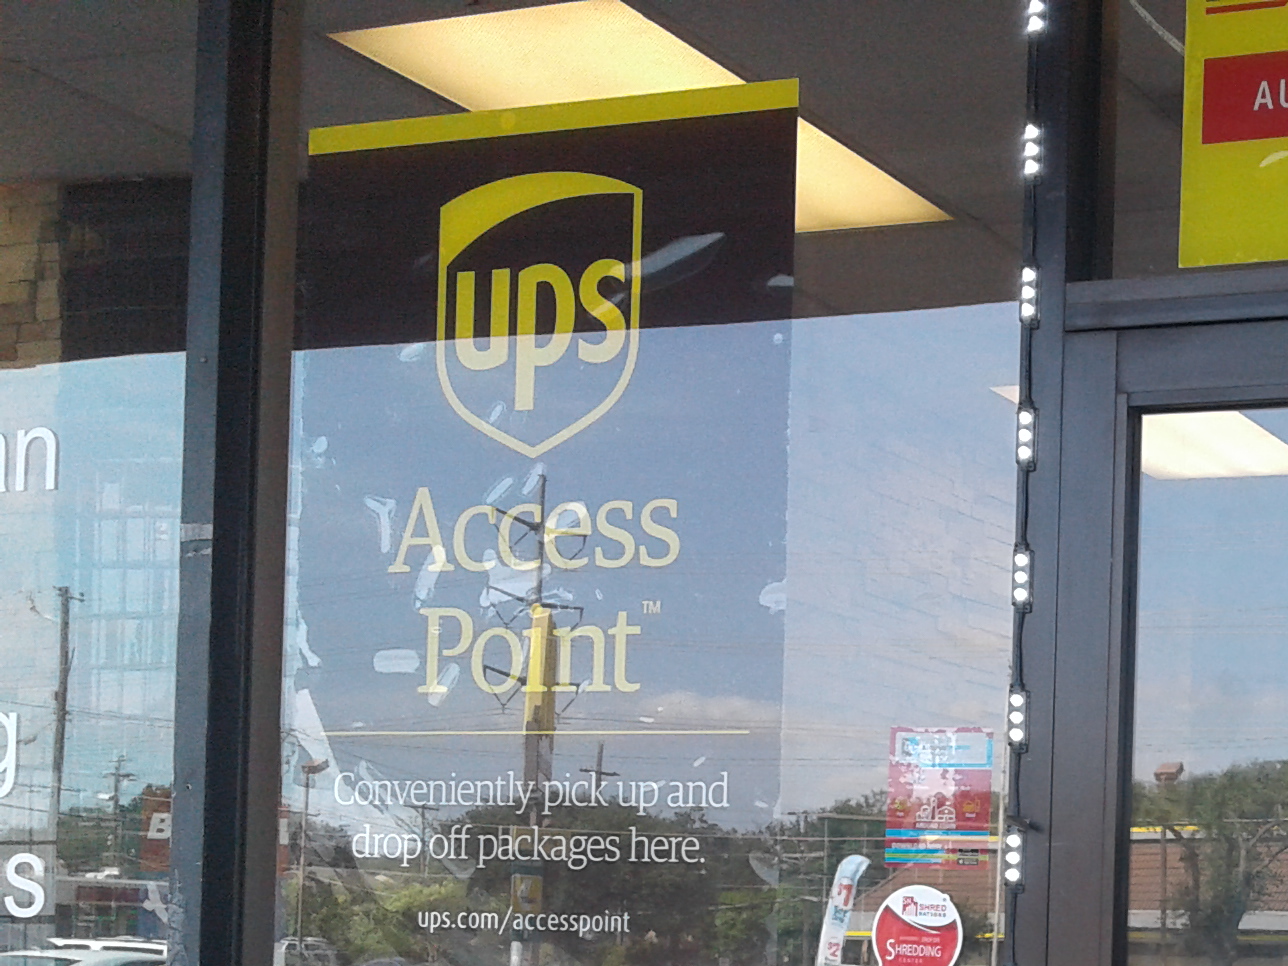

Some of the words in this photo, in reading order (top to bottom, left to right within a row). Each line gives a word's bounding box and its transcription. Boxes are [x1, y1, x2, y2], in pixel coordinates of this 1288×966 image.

[455, 258, 626, 411] ups
[388, 486, 681, 573] Access
[417, 606, 642, 694] Point
[334, 770, 534, 814] Conveniently
[542, 771, 607, 815] pick
[617, 781, 660, 814] up
[669, 771, 730, 808] and
[352, 825, 421, 867] drop
[429, 823, 472, 861] off
[479, 827, 620, 869] packages
[629, 826, 706, 864] here.
[418, 907, 631, 937] ups.com/accesspoint
[919, 903, 947, 912] SHRED
[885, 938, 942, 961] SHREDDING
